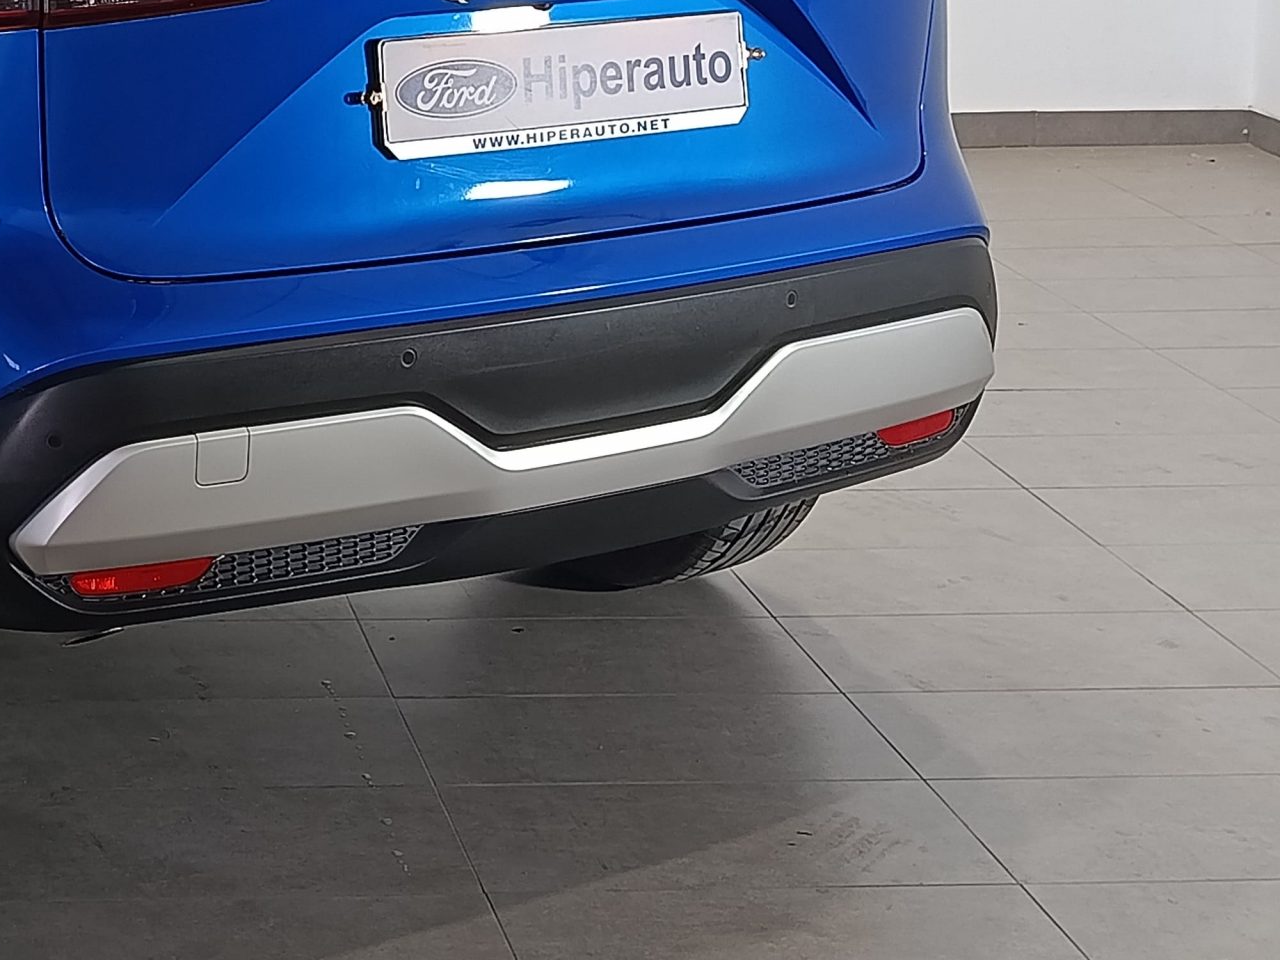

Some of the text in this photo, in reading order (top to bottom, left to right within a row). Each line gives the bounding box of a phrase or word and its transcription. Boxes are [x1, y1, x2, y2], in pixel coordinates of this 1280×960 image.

[416, 67, 501, 119] Ford
[522, 42, 733, 110] Hiperauto
[472, 117, 671, 150] WWW.HIPERAUTO.NET
